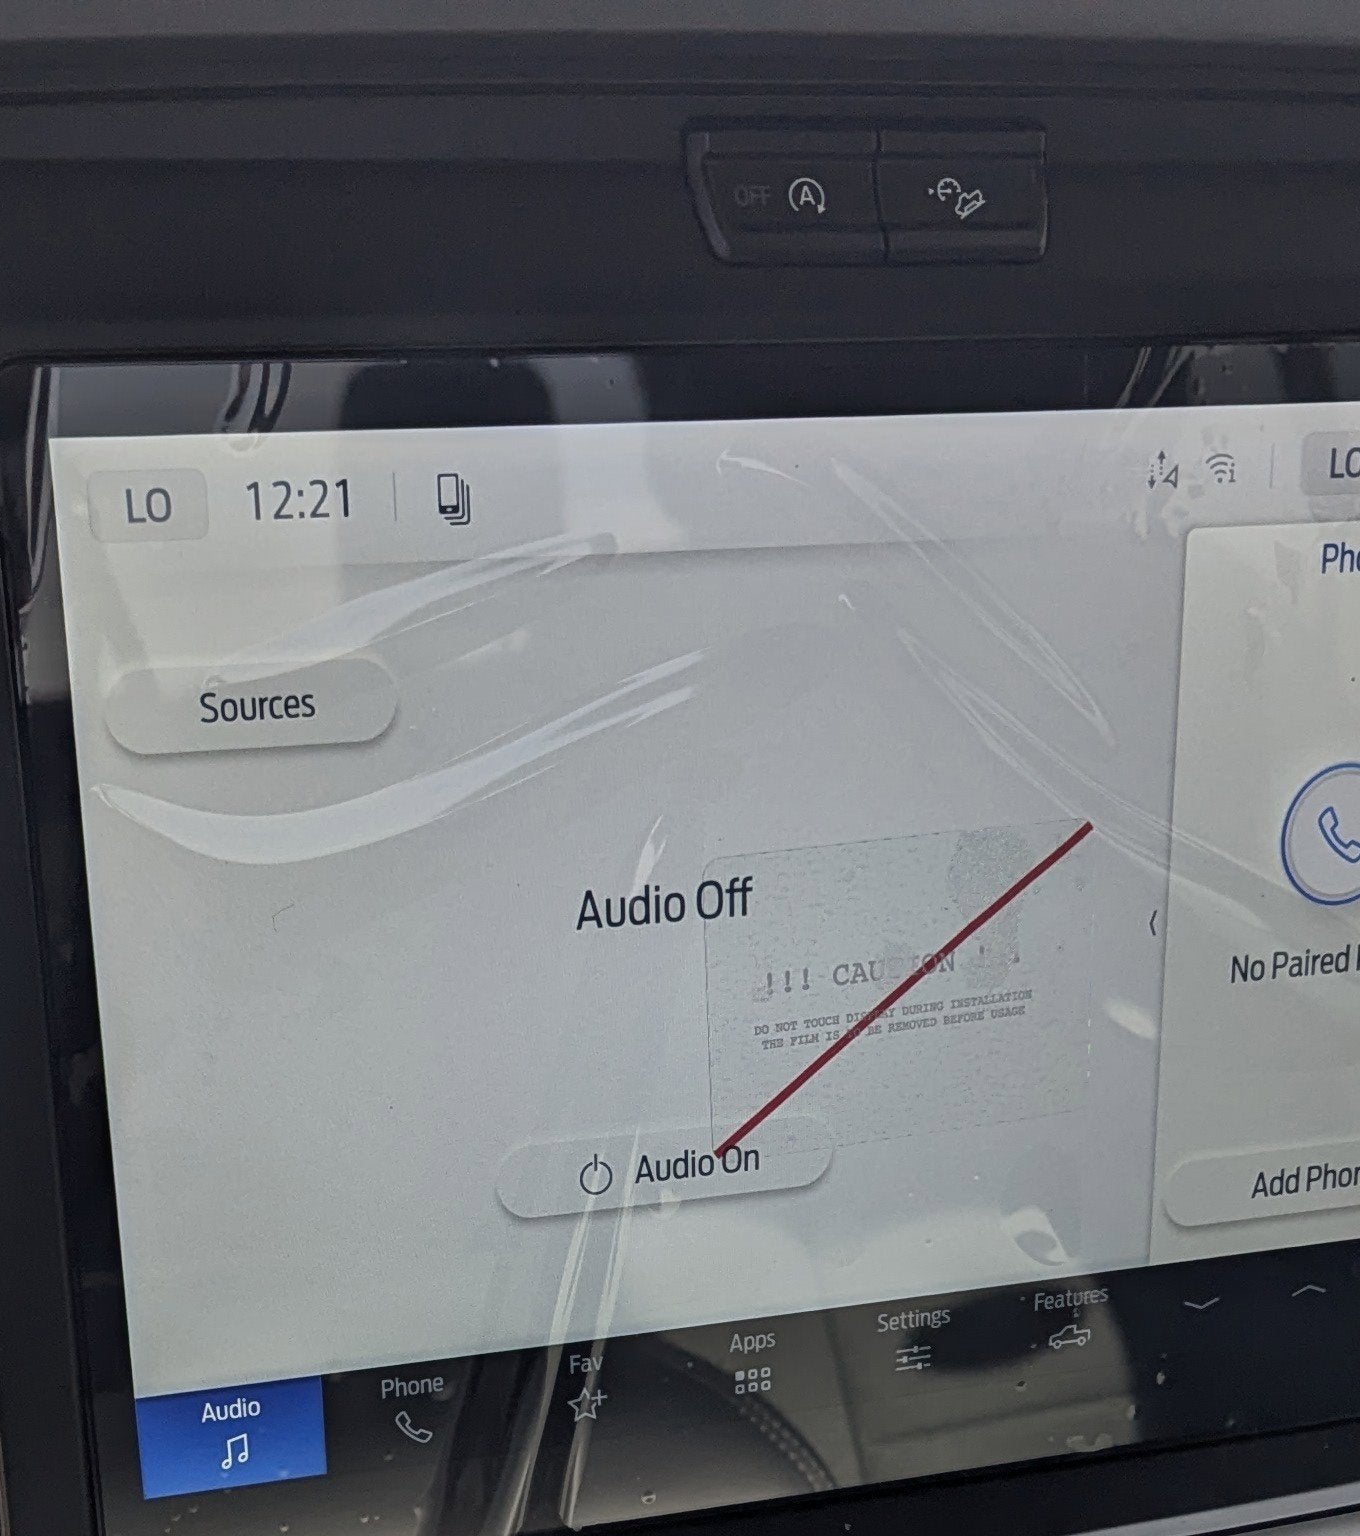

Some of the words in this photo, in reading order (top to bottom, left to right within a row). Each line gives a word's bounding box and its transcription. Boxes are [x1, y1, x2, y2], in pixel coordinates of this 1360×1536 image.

[125, 487, 172, 524] LO
[246, 478, 350, 521] 12:21
[199, 692, 316, 724] Sources
[576, 884, 686, 931] Audio
[696, 875, 753, 920] Off
[832, 950, 956, 986] CAUION
[1230, 954, 1266, 984] No
[1271, 945, 1350, 980] Paired
[754, 1024, 770, 1036] DO
[775, 1020, 798, 1033] NOT
[803, 1014, 840, 1029] TOUCH
[845, 1007, 896, 1024] DISY
[901, 1001, 944, 1016] DURING
[950, 989, 1033, 1009] INSTALLATION
[761, 1038, 784, 1050] THE
[789, 1032, 820, 1046] FILM
[825, 1030, 840, 1041] IS
[888, 1017, 938, 1033] REMOVED
[943, 1011, 985, 1025] BEFORE
[990, 1005, 1026, 1019] USAGE
[634, 1149, 715, 1184] Audio
[721, 1145, 760, 1174] On
[1251, 1170, 1301, 1199] Add
[1034, 1286, 1109, 1311] Features
[877, 1309, 950, 1333] Settings
[729, 1332, 776, 1355] Apps
[570, 1354, 603, 1375] Fav
[381, 1376, 444, 1400] Phone
[201, 1397, 261, 1423] Audio
